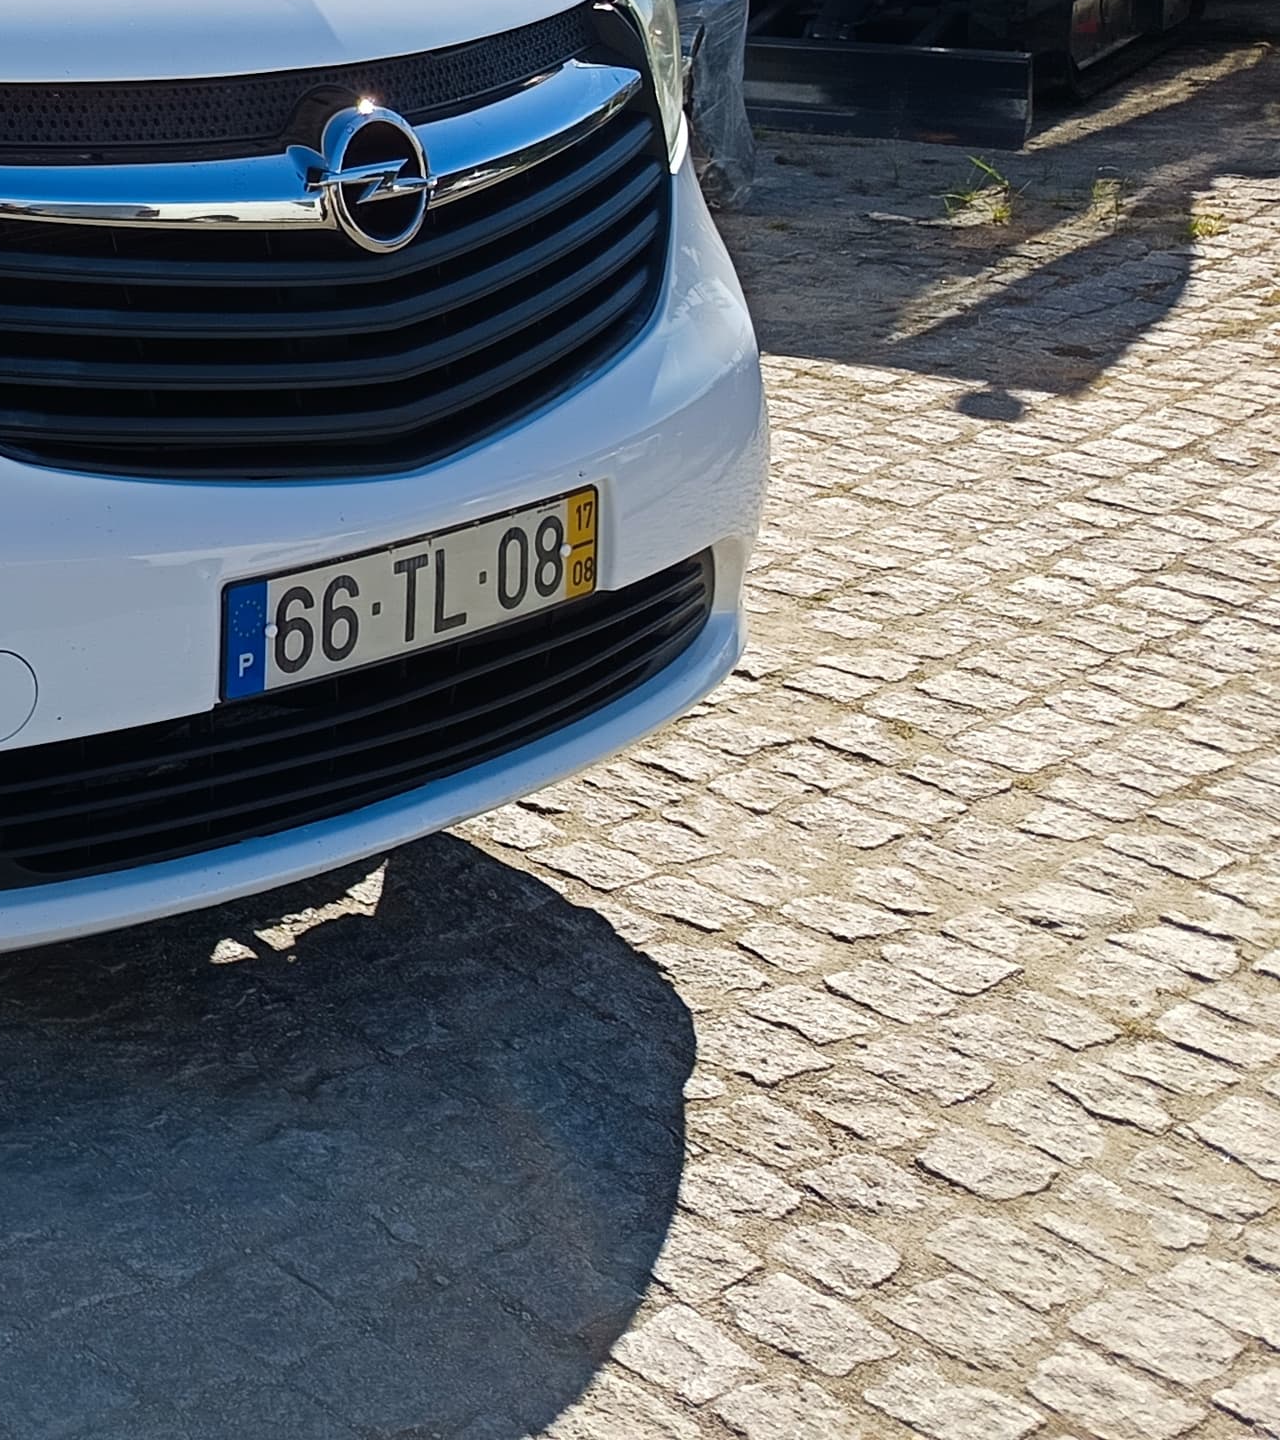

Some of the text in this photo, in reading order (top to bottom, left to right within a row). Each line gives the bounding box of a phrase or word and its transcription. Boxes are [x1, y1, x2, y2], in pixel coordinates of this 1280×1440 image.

[575, 501, 593, 532] 17
[572, 556, 594, 586] 08
[238, 652, 255, 678] P
